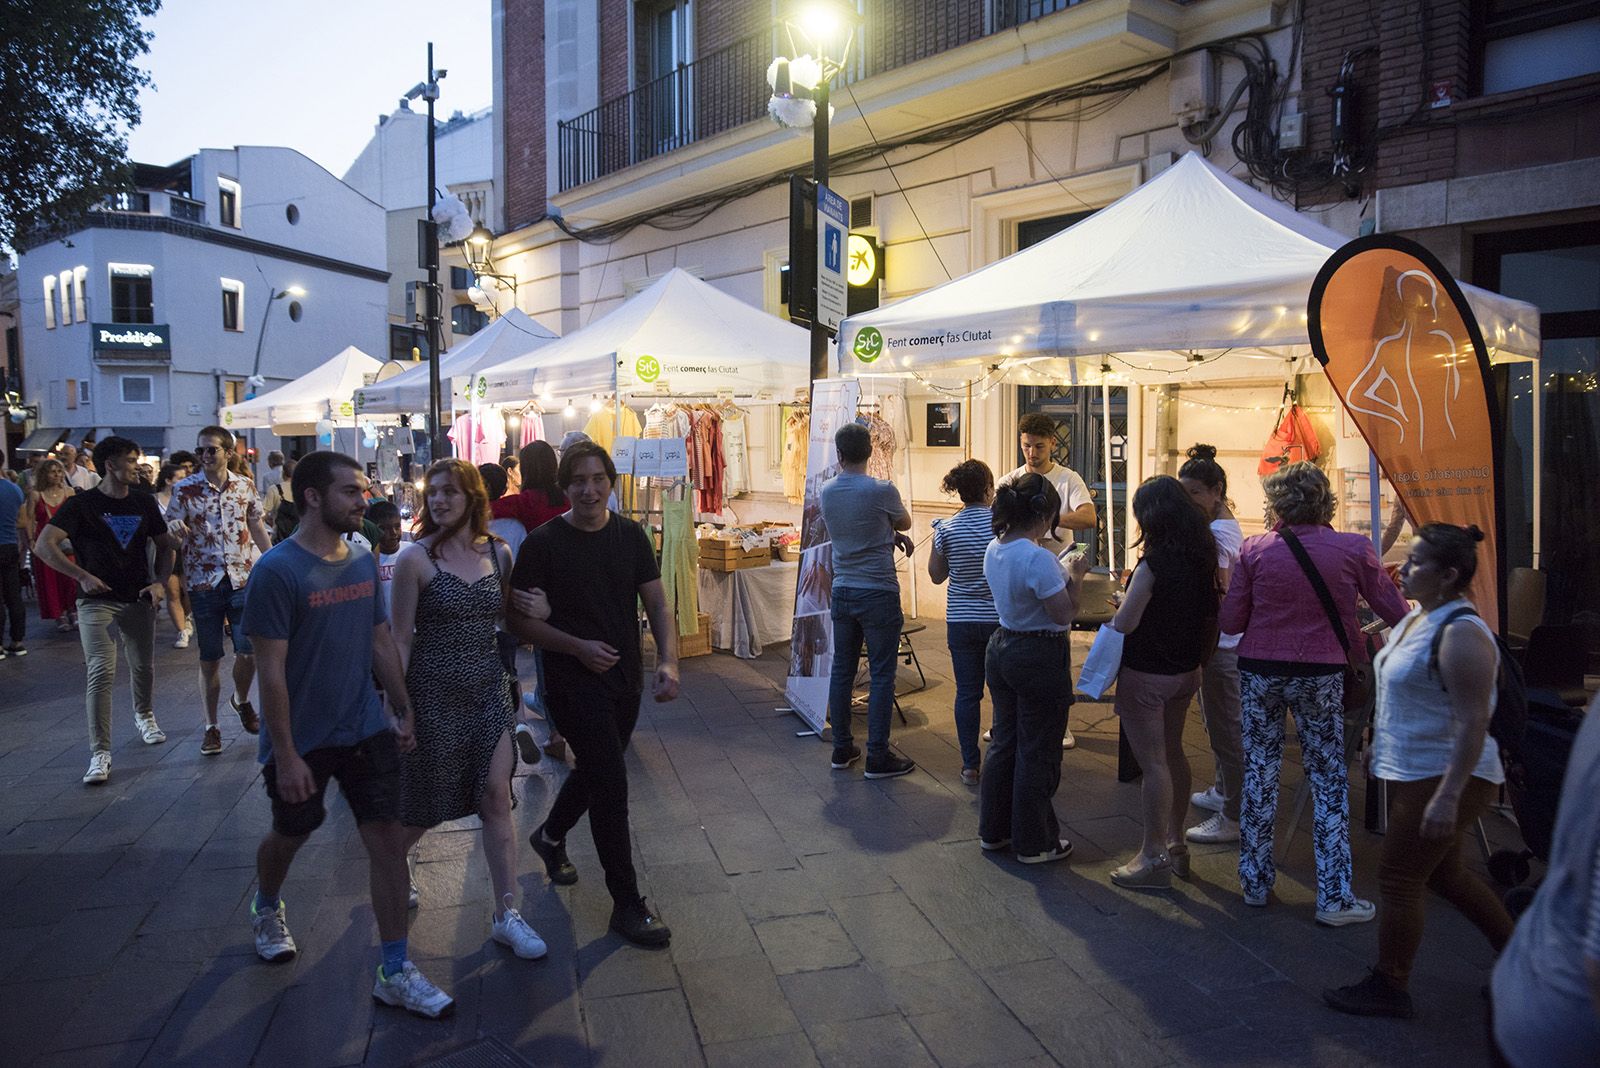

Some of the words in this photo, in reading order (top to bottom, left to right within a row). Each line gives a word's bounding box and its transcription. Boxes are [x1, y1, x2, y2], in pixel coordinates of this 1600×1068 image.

[99, 330, 163, 347] Proddigia
[887, 337, 907, 348] Fent
[909, 334, 945, 346] comerç
[946, 332, 960, 343] fas
[962, 329, 992, 341] Ciutat
[663, 364, 679, 373] Fent
[680, 365, 707, 374] comerç
[707, 364, 718, 373] fas
[718, 364, 739, 374] Ciutat
